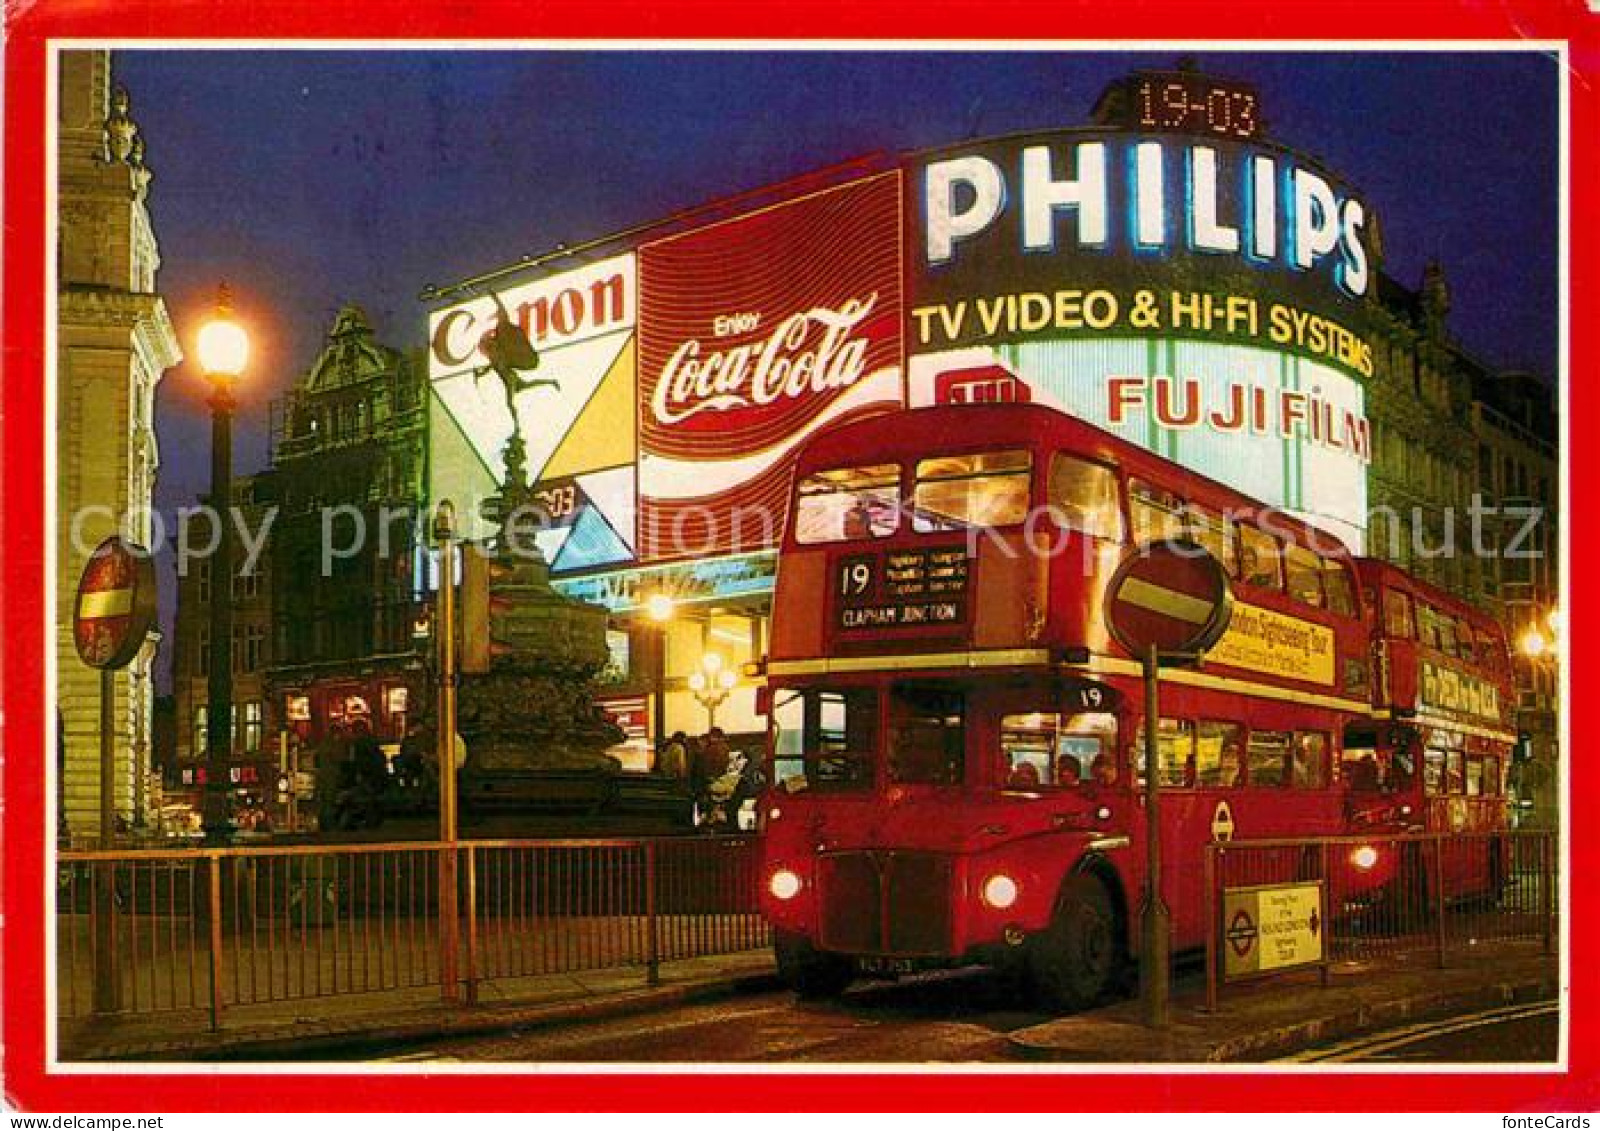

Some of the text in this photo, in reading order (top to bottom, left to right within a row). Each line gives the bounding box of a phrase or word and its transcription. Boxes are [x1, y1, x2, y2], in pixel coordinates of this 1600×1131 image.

[1140, 81, 1255, 136] 19-03
[927, 142, 1368, 296] PHILIPS
[713, 312, 762, 337] Enjoy
[912, 289, 1374, 377] TV VIDEO & HI-FI SYSTEMS
[652, 290, 878, 424] Coca-Cola
[1107, 376, 1270, 432] FUJI
[842, 563, 871, 596] 19
[842, 607, 897, 627] CLAPHAM
[1080, 687, 1103, 707] 19
